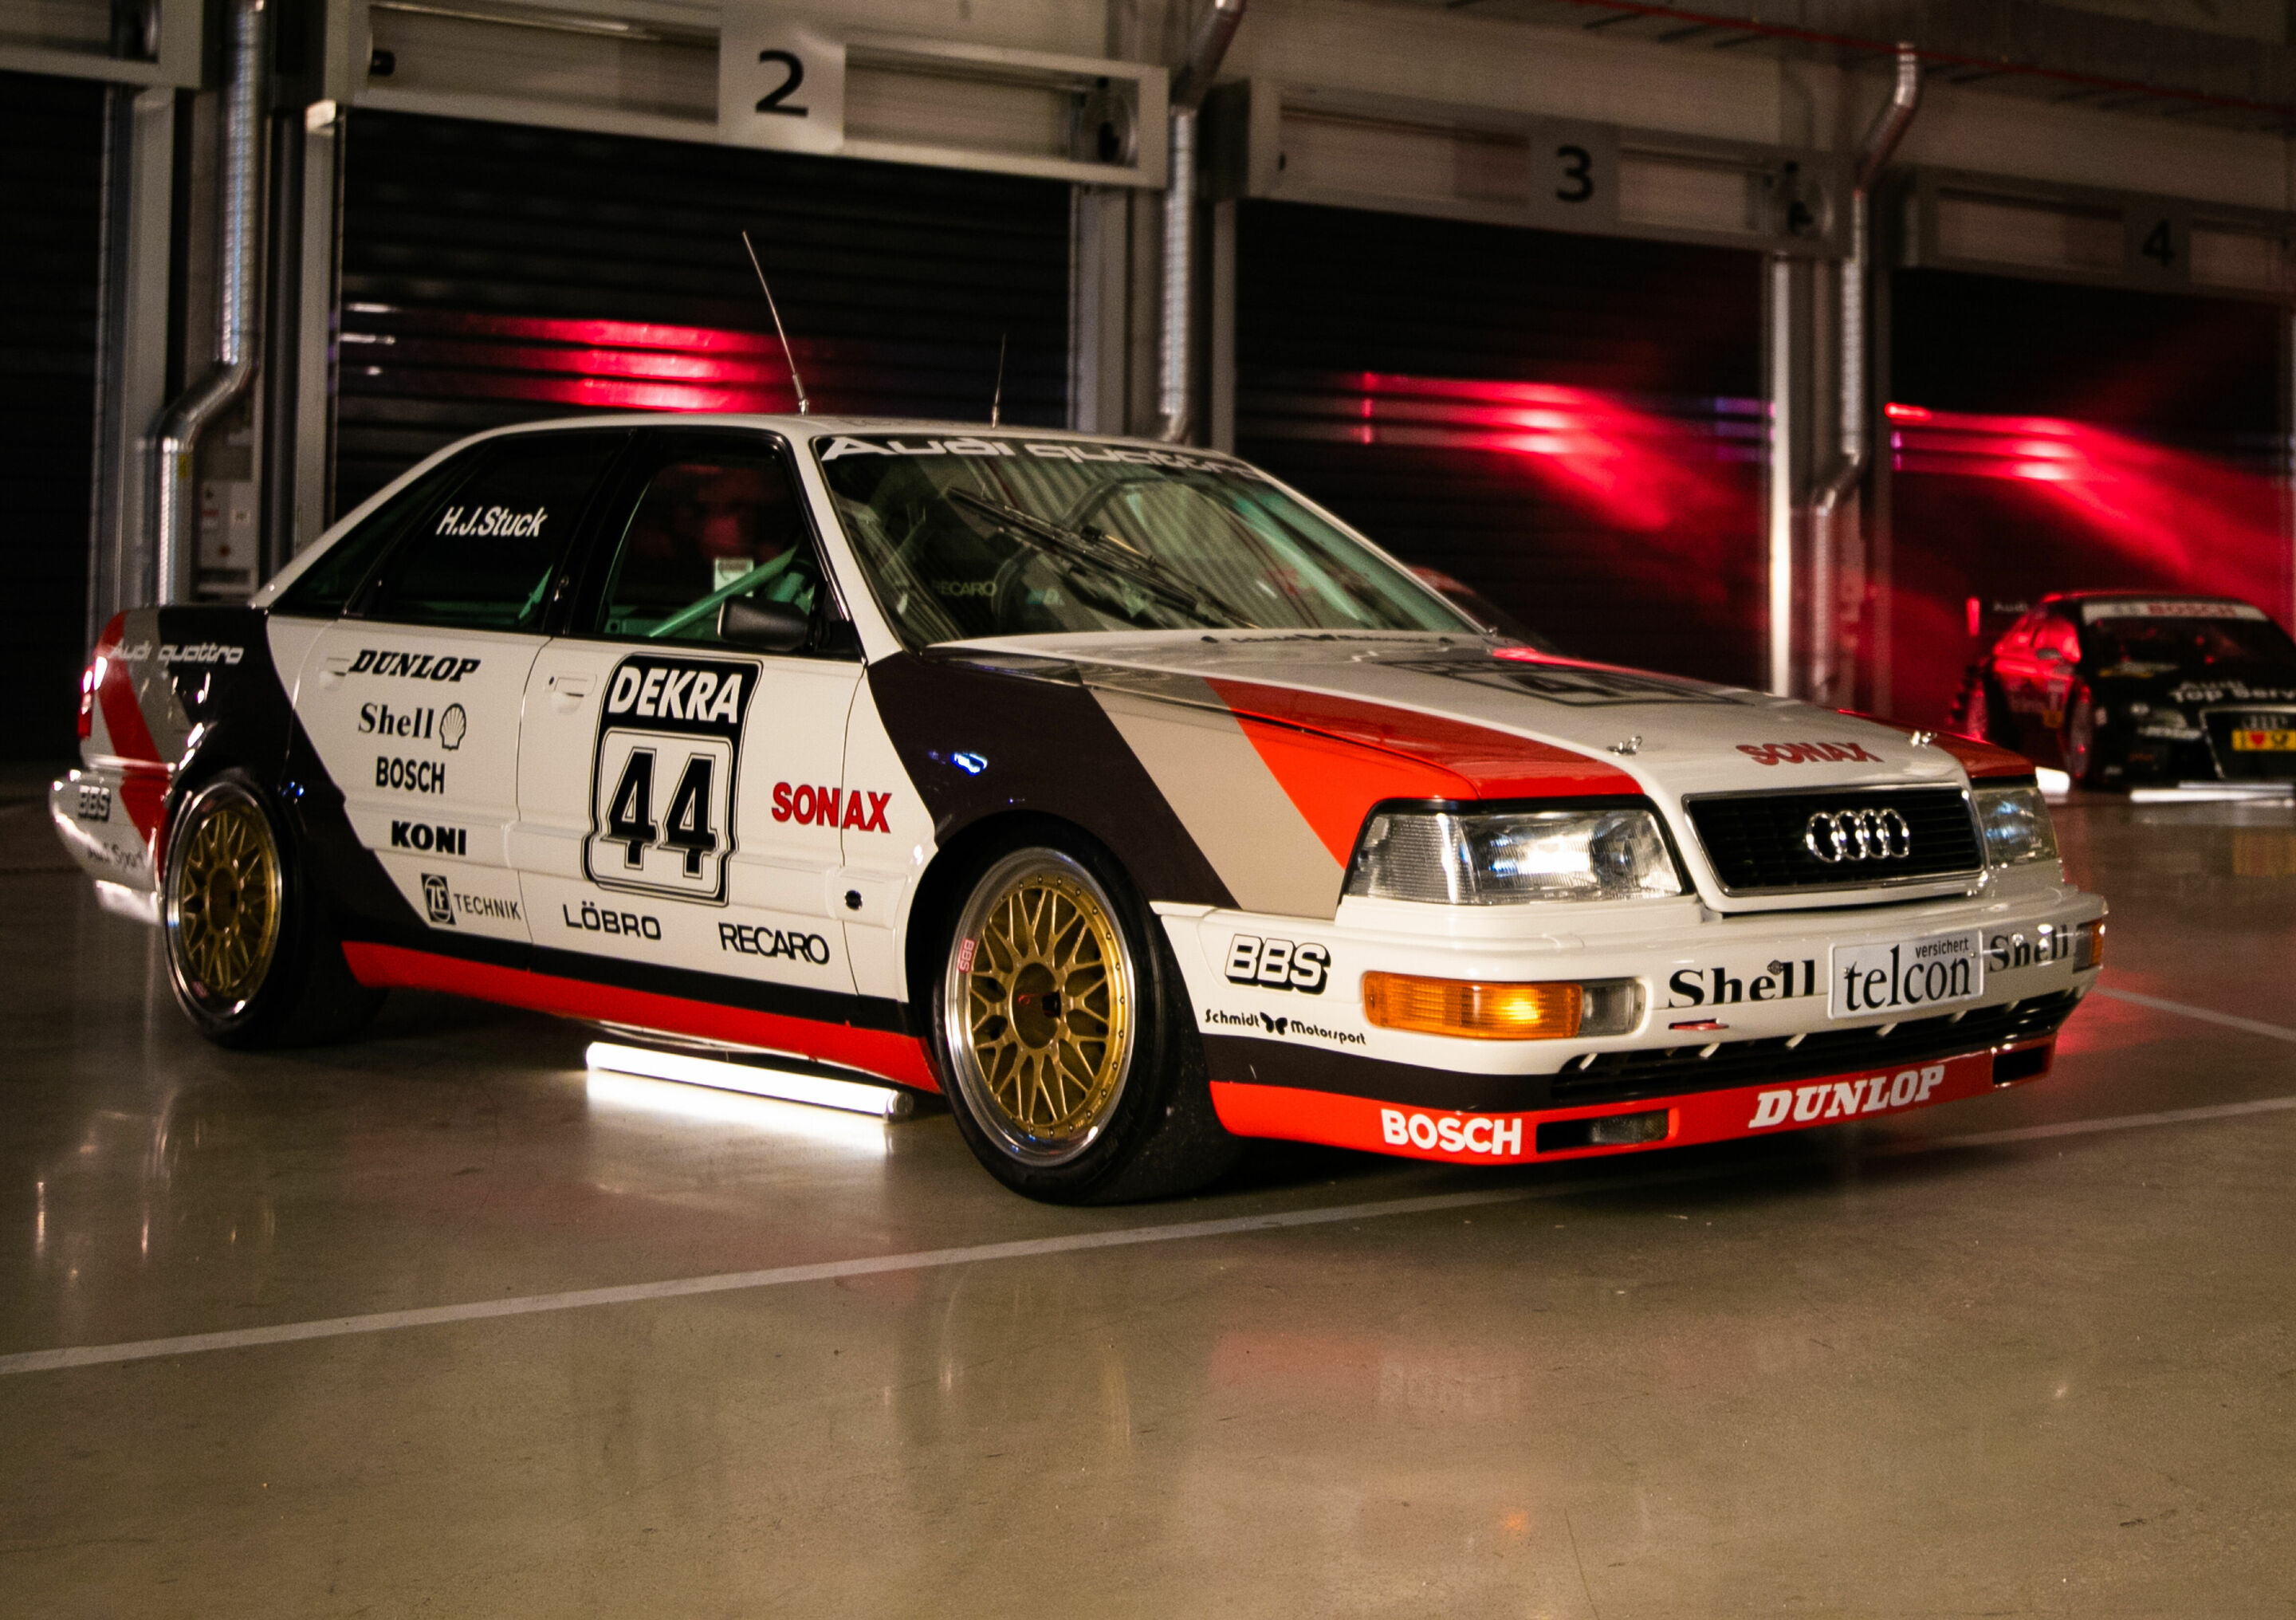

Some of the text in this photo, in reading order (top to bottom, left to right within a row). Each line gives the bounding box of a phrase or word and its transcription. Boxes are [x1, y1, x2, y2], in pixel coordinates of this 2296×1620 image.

[755, 49, 809, 118] 2
[1557, 144, 1593, 203] 3
[2141, 217, 2176, 267] 4
[821, 437, 1264, 478] Audi quattro
[435, 505, 548, 537] H.J.Stuck
[107, 638, 245, 666] Audi quattro
[348, 649, 481, 682] DUNLOP
[608, 666, 743, 723] DEKRA
[358, 702, 434, 738] Shell
[1736, 742, 1885, 765] SONAX
[375, 756, 445, 794] BOSCH
[599, 746, 719, 879] 44
[771, 781, 893, 834] SONAX
[391, 820, 467, 856] KONI
[453, 893, 522, 921] TECHNIK
[562, 901, 662, 941] LÖBRO
[718, 922, 830, 965] RECARO
[959, 938, 975, 973] BBS
[1915, 938, 1970, 959] versichert
[1225, 934, 1331, 995] BBS
[1669, 959, 1816, 1009] Shell
[1844, 946, 1972, 1011] telcon
[1205, 1009, 1366, 1045] Schmidt Motorsport
[1748, 1065, 1945, 1129] DUNLOP
[1381, 1109, 1522, 1156] BOSCH
